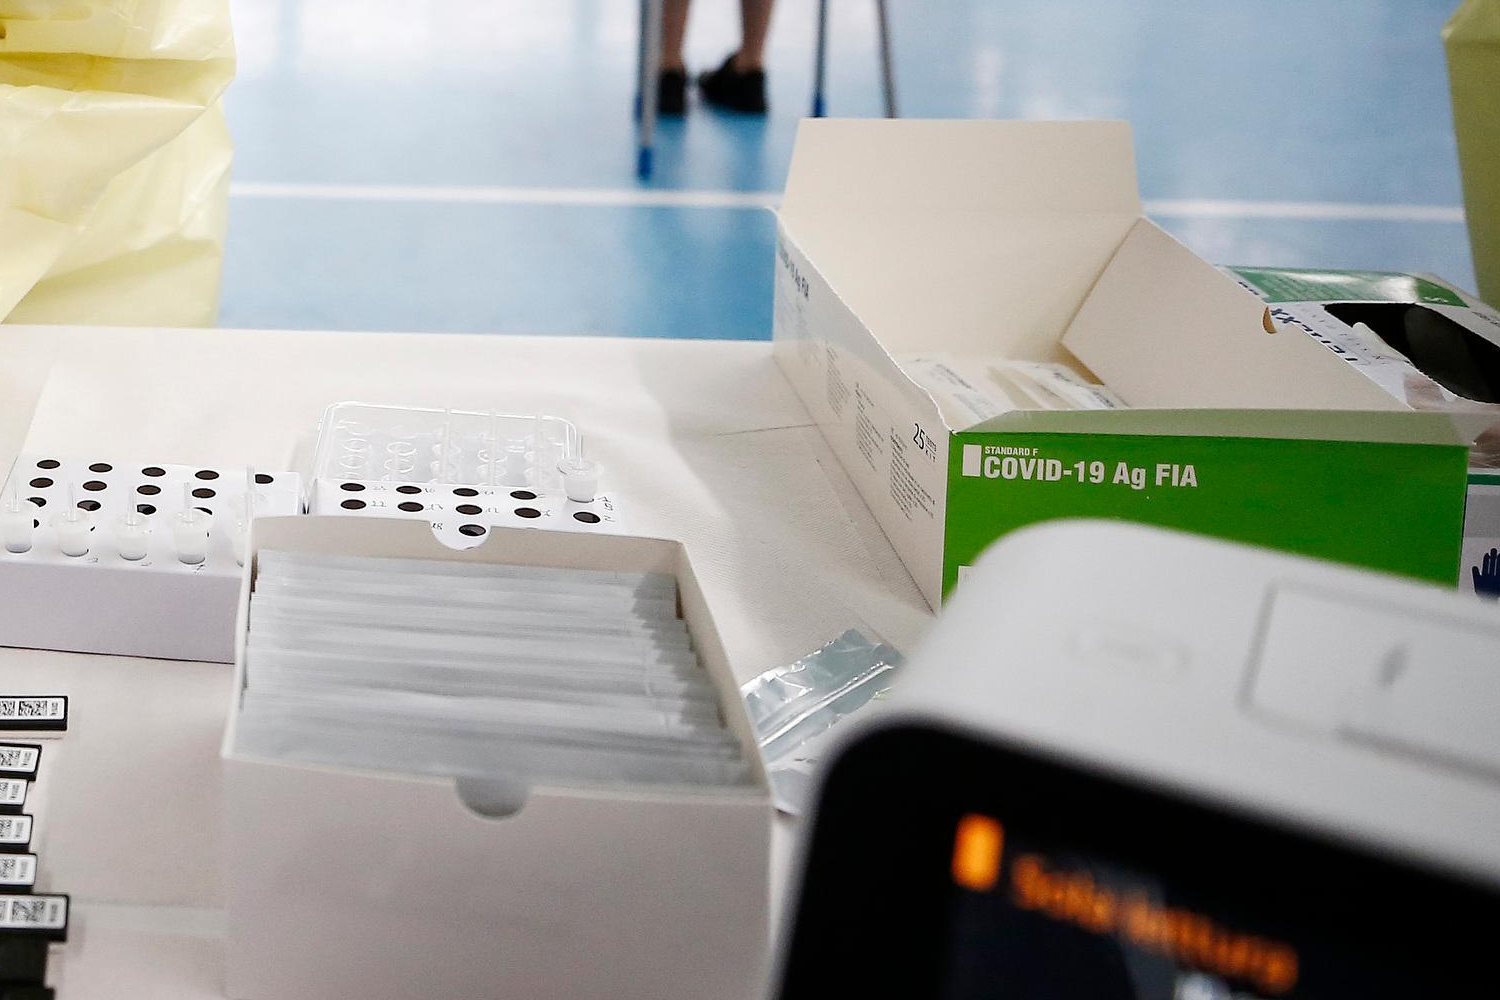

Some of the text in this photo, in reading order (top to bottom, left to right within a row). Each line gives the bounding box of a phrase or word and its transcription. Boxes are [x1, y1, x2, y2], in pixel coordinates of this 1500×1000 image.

[913, 423, 924, 450] 25
[985, 445, 1038, 457] STANDARD F
[984, 456, 1197, 490] COVID-19 Ag FIA
